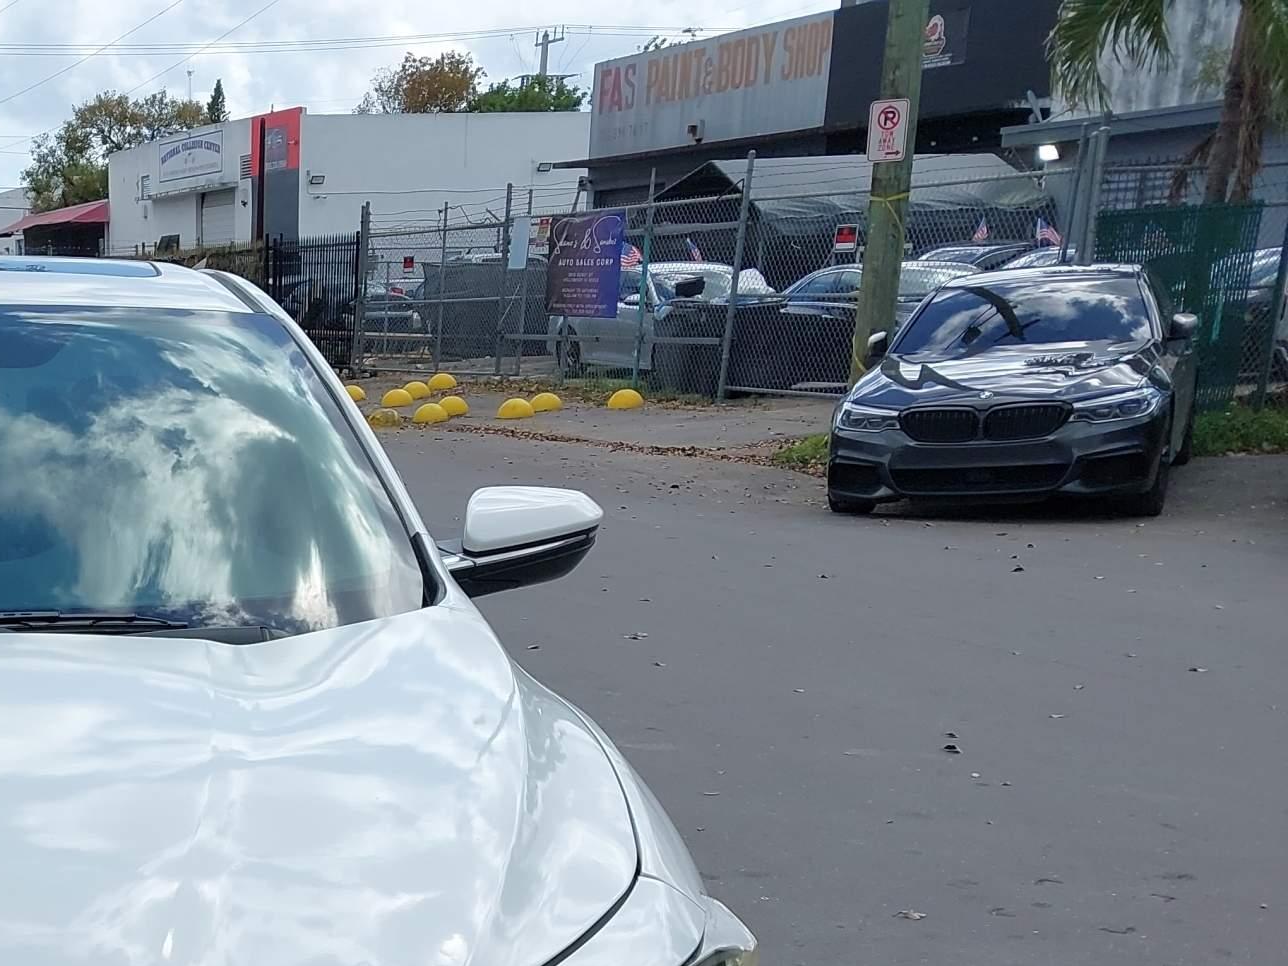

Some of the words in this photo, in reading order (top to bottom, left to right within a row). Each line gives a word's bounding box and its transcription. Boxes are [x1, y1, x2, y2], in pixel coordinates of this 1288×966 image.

[599, 63, 636, 115] FAS
[716, 32, 778, 92] BODY
[781, 17, 832, 81] SHOP
